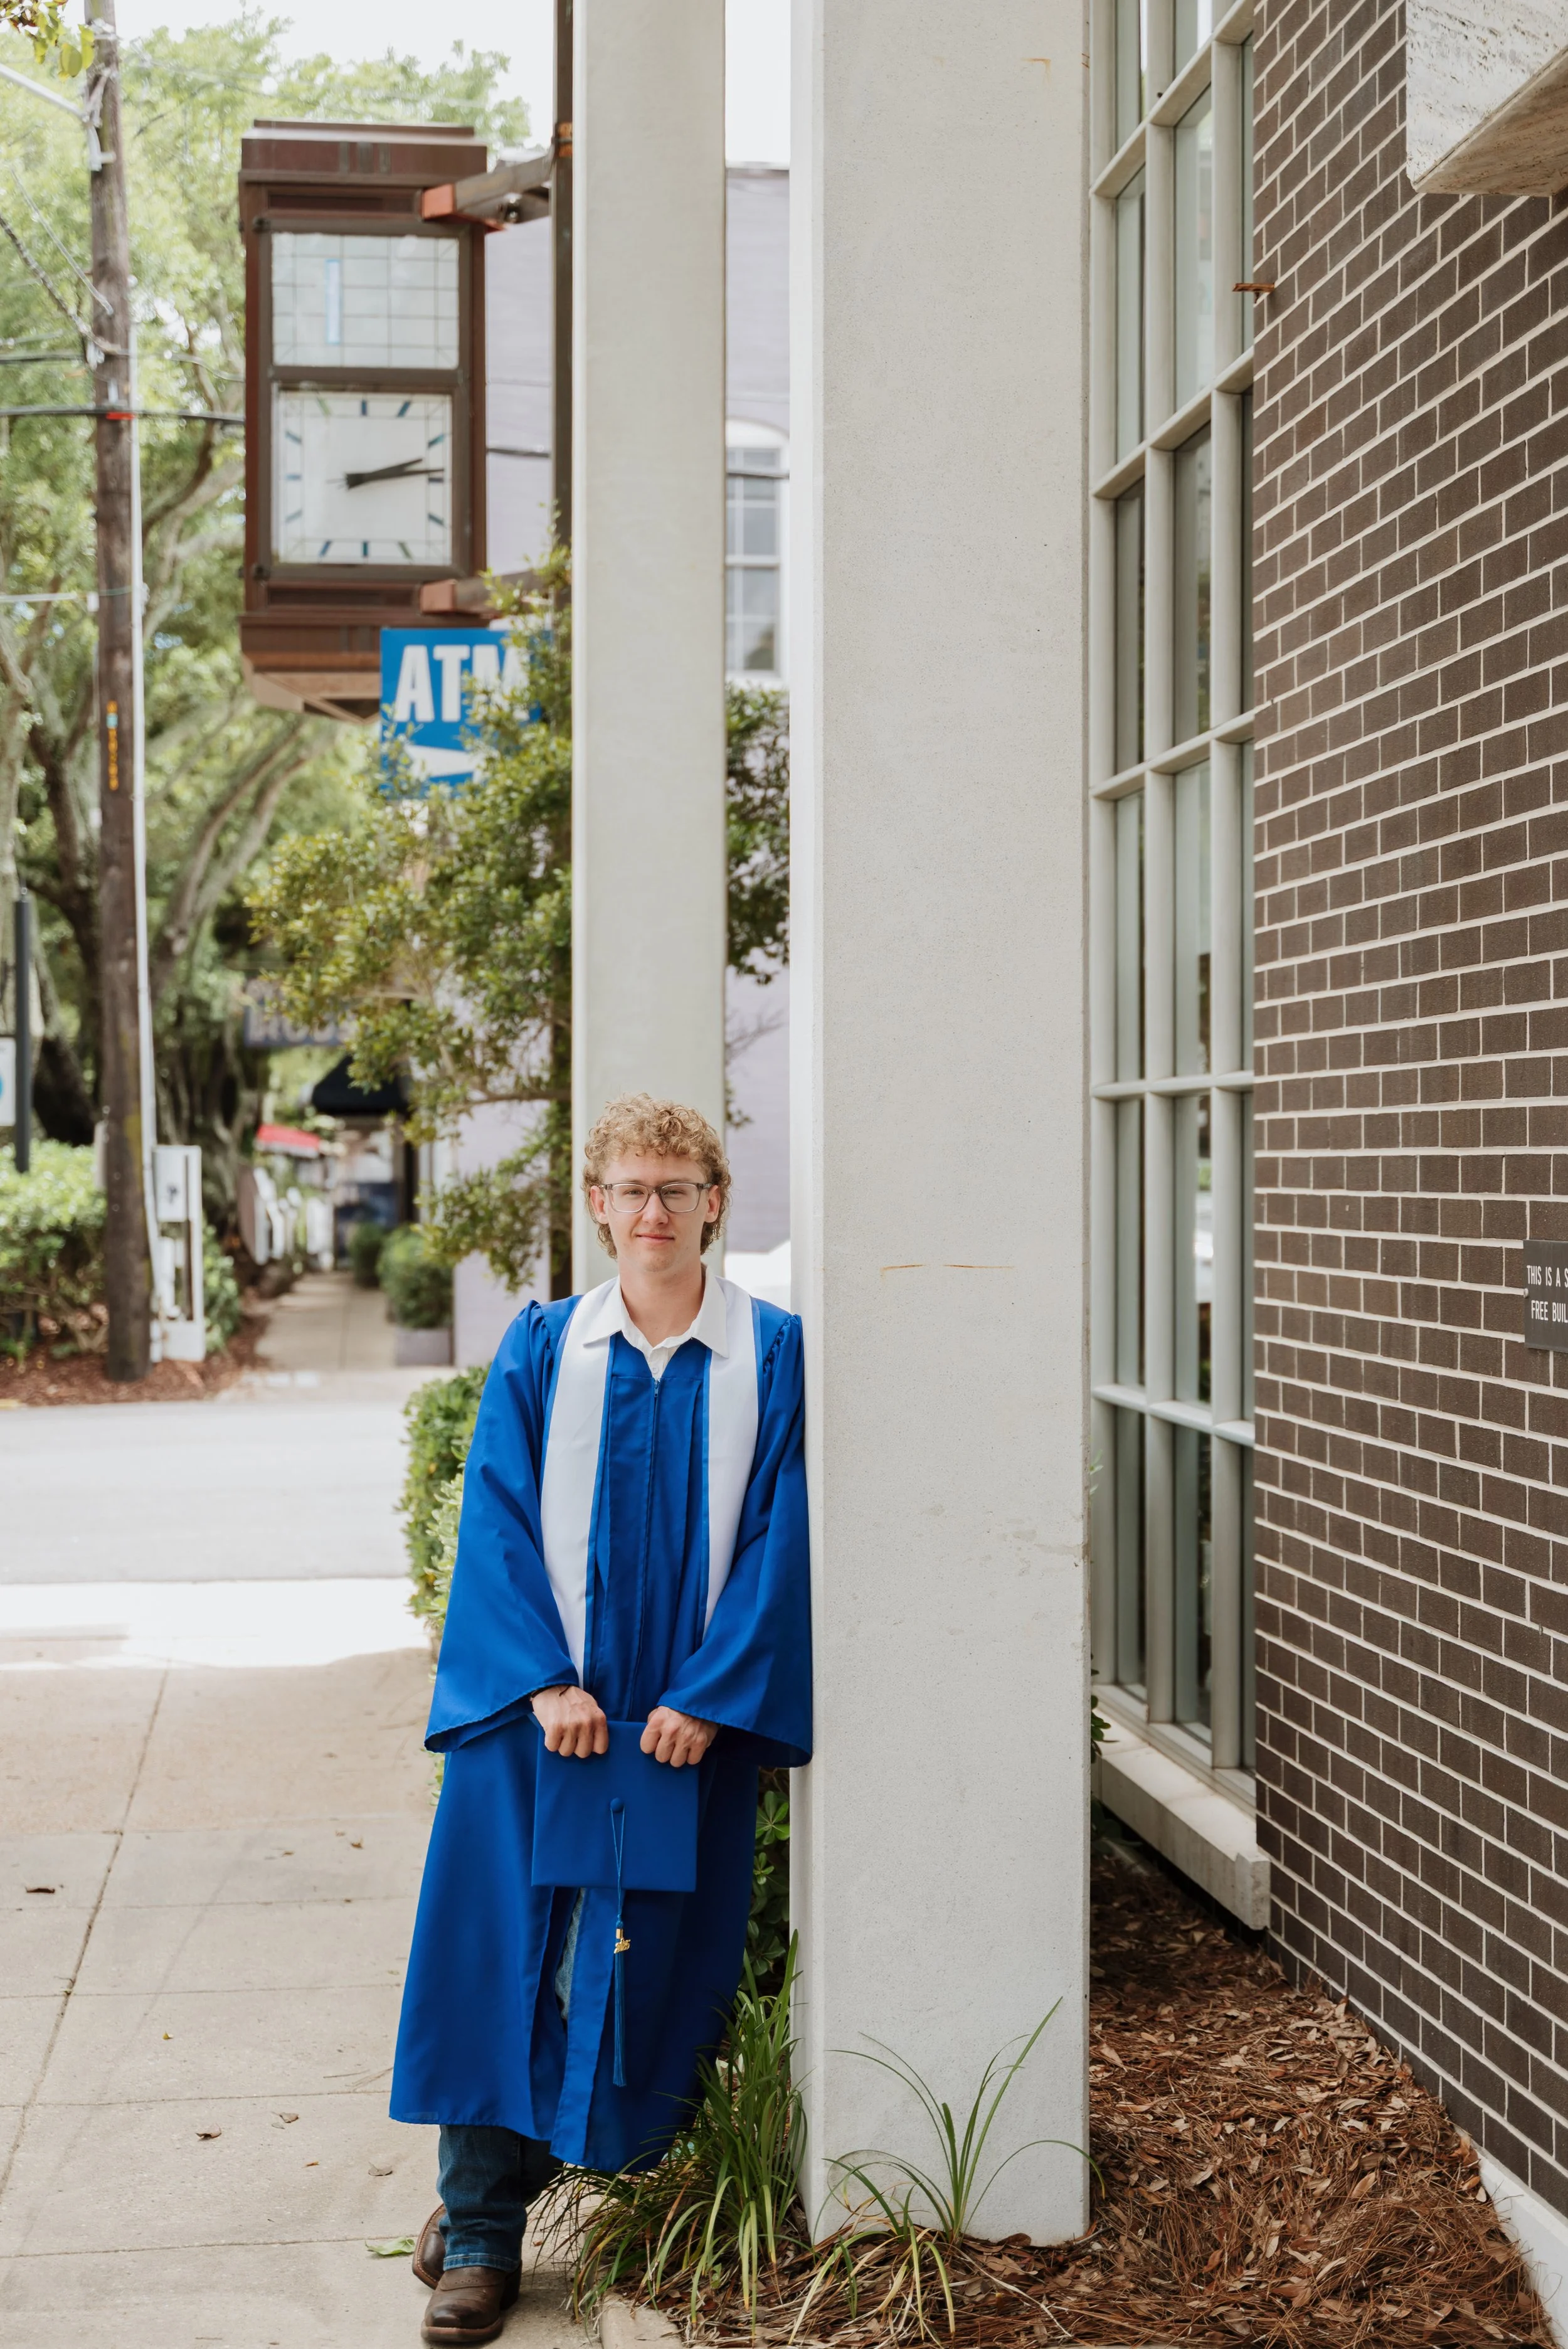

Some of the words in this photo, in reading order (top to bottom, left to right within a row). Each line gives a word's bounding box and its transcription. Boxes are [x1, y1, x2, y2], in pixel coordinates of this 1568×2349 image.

[393, 644, 531, 722] ATM
[1527, 1265, 1542, 1285] THIS
[1545, 1266, 1552, 1286] IS
[1556, 1268, 1560, 1287] A
[1531, 1300, 1549, 1320] FREE
[1552, 1302, 1568, 1323] BUIL
